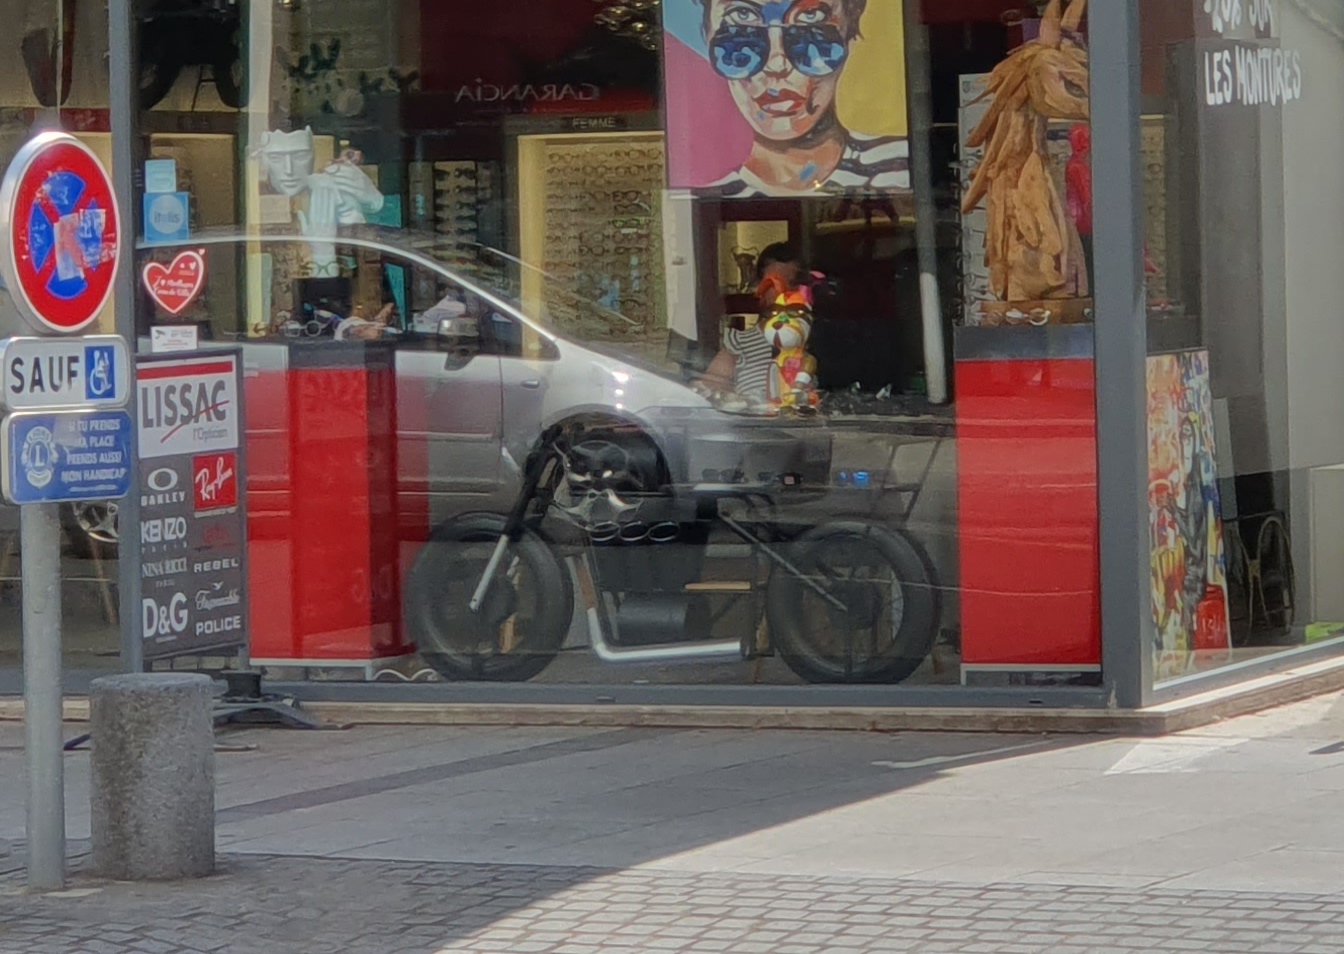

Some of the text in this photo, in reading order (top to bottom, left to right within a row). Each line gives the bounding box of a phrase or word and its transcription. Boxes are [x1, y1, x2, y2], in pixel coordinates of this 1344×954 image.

[1205, 45, 1302, 106] LES MONTURES
[572, 117, 616, 129] FEMME
[10, 356, 80, 394] SAUF
[141, 380, 227, 428] LISSAC
[141, 516, 187, 544] KENZO
[142, 592, 188, 638] D&G
[196, 615, 241, 635] POLICE
